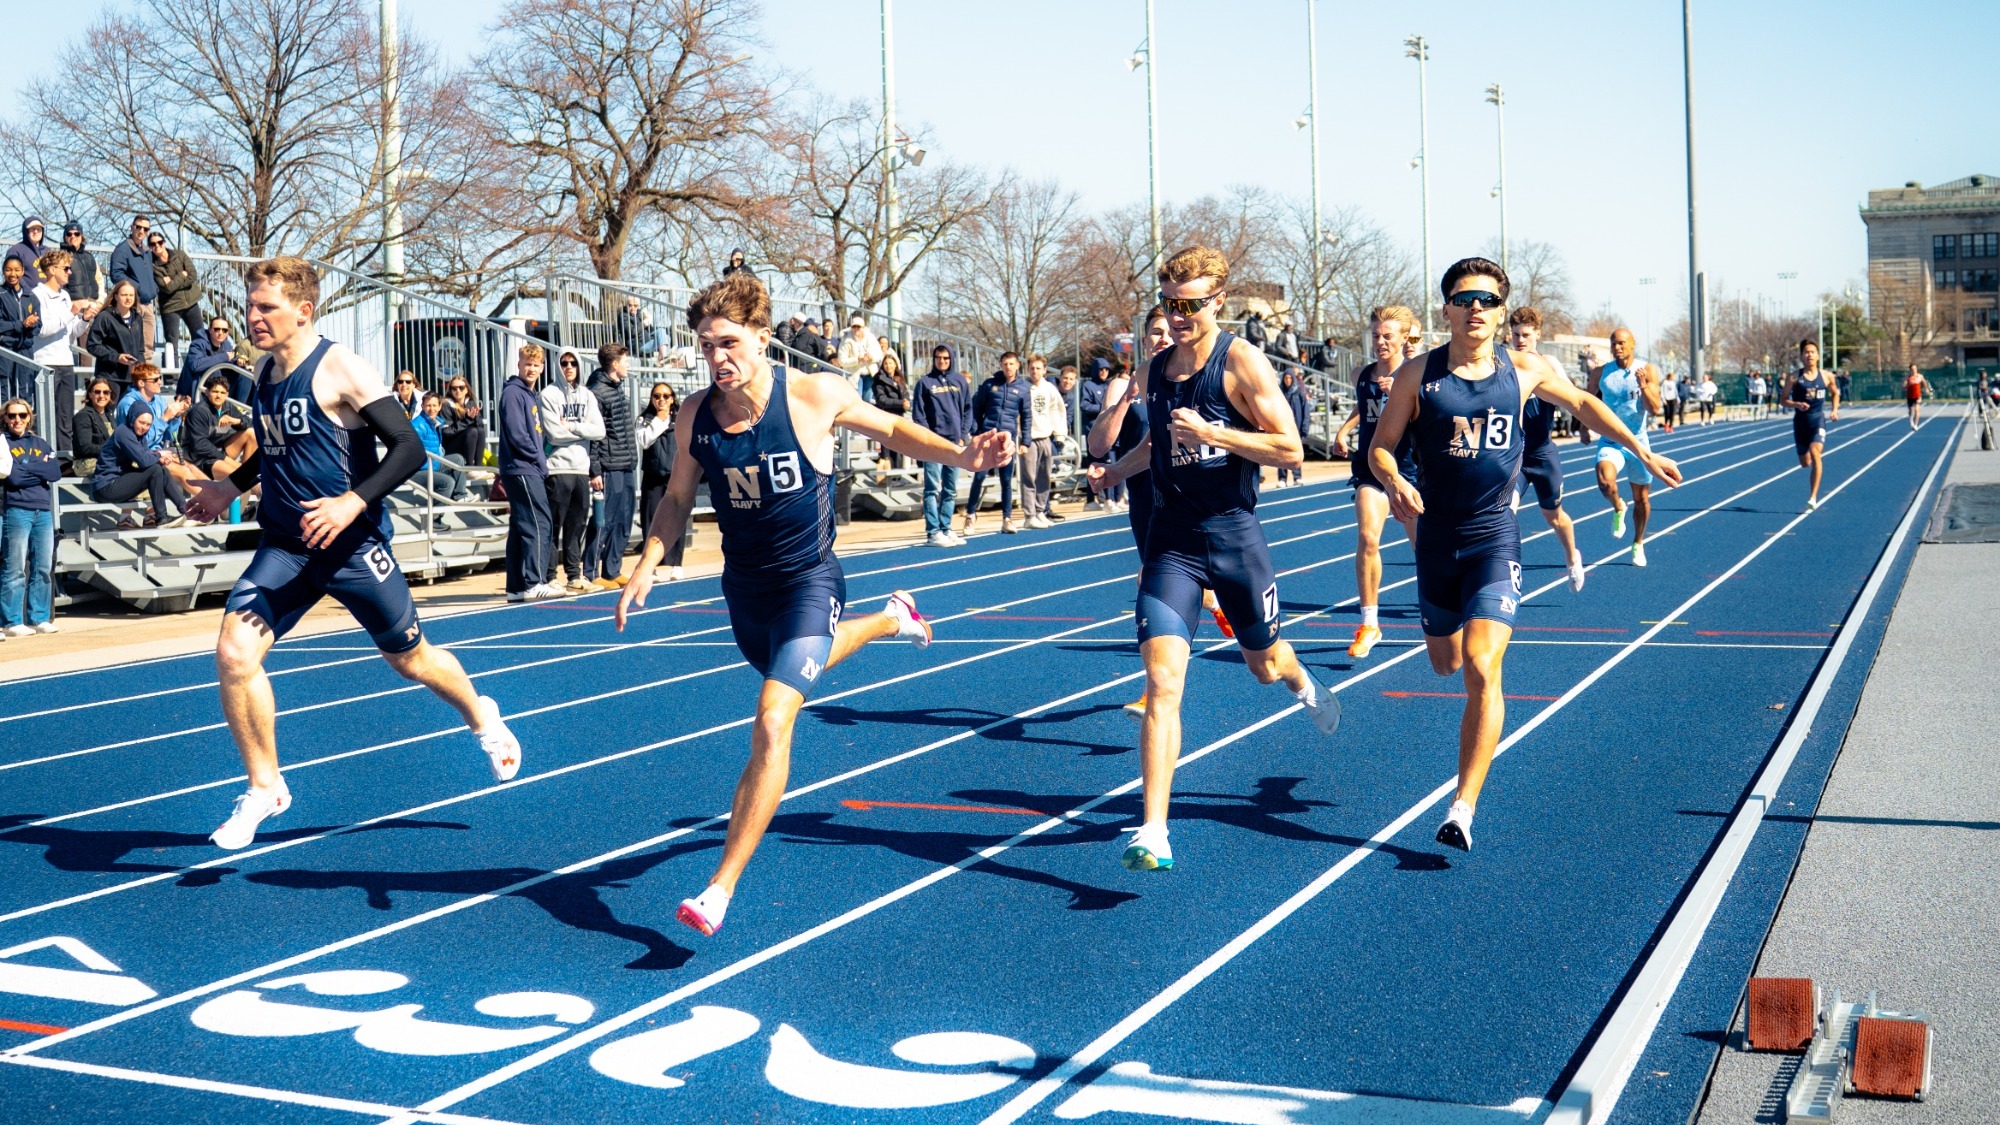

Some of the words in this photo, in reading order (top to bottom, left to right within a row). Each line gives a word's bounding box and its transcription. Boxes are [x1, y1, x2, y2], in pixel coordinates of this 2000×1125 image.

[288, 400, 305, 433] 8
[562, 404, 586, 417] NAVY
[1367, 399, 1383, 417] N
[261, 413, 286, 446] N
[1450, 416, 1486, 449] N
[1489, 416, 1508, 447] 3
[264, 446, 287, 456] NAVY
[1171, 453, 1200, 467] NAVY
[1448, 447, 1479, 459] NAVY
[723, 466, 761, 499] N
[772, 456, 797, 490] 5
[730, 500, 762, 510] NAVY
[365, 547, 391, 576] 8
[1264, 586, 1275, 619] 7
[1500, 595, 1518, 616] N
[800, 656, 822, 682] N
[190, 970, 594, 1056] 3
[590, 1006, 1037, 1110] 2
